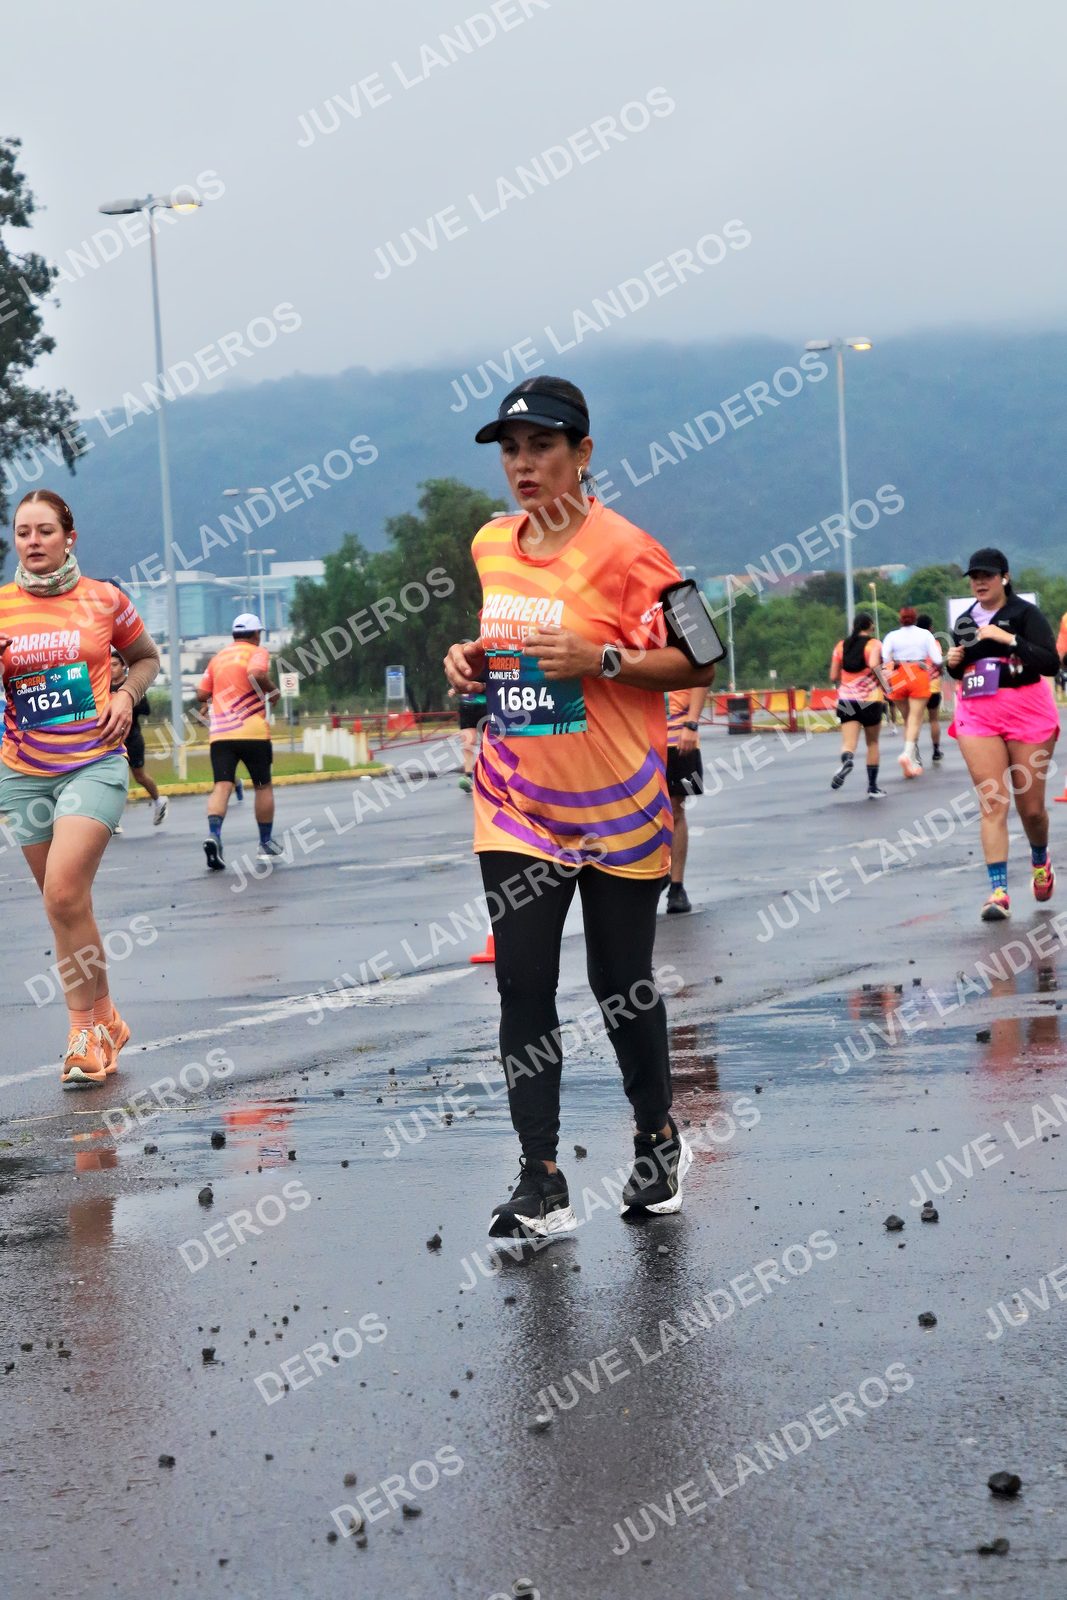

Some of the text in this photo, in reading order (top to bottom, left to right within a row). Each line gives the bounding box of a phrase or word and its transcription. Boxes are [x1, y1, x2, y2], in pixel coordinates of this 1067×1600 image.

[481, 594, 564, 626] CARRERA
[10, 630, 80, 653] CARRERA
[480, 623, 536, 640] OMNILIFE
[11, 650, 64, 666] OMNILIFE
[489, 657, 520, 671] CARRERA
[28, 688, 73, 713] 1621
[497, 687, 555, 711] 1684
